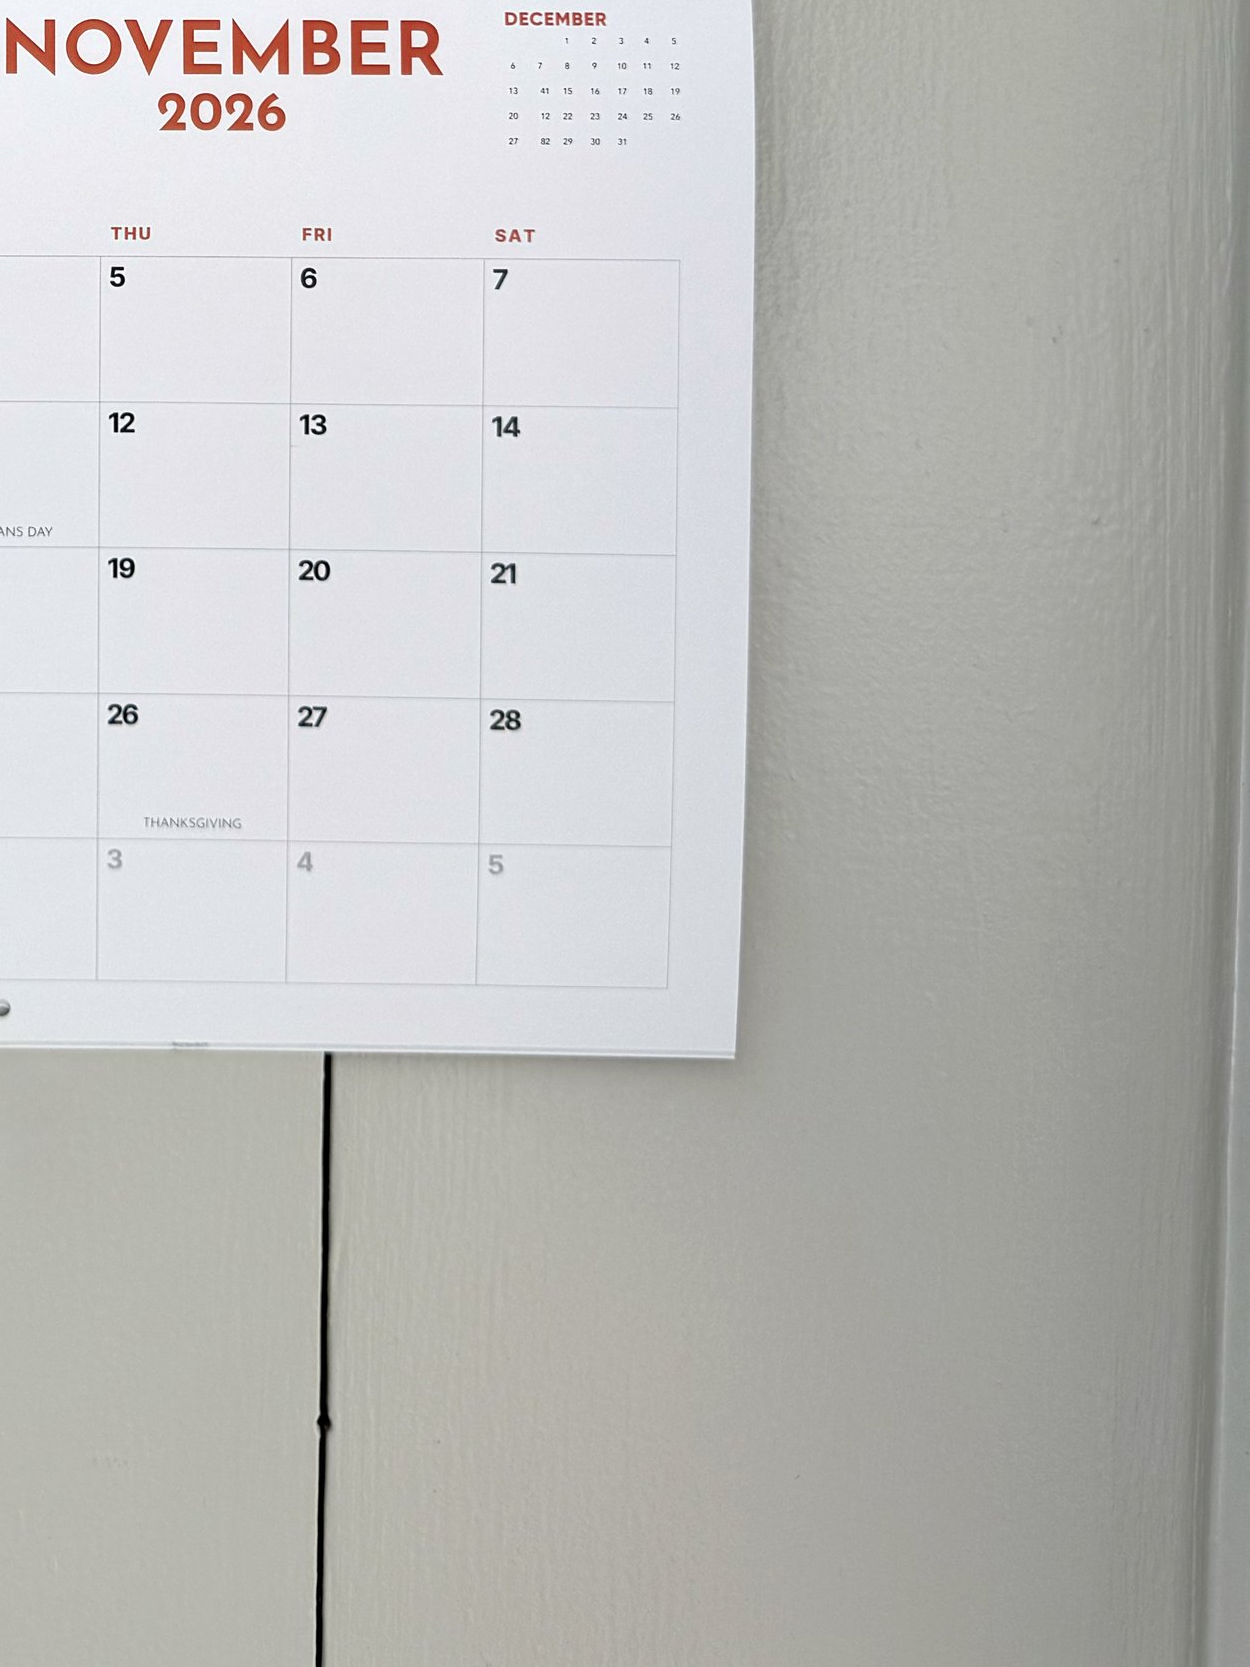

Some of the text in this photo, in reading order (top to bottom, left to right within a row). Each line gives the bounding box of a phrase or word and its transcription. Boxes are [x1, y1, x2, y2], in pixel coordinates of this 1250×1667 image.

[504, 11, 607, 27] DECEMBER
[5, 16, 444, 77] NOVEMBER
[591, 36, 597, 45] 2
[618, 37, 625, 45] 3
[643, 37, 650, 45] 4
[671, 37, 677, 46] 5
[510, 61, 680, 71] 6 7 8 9 10 11 12
[508, 86, 519, 95] 13
[563, 87, 573, 95] 15
[590, 87, 601, 96] 16
[617, 87, 628, 95] 17
[643, 87, 654, 96] 18
[670, 87, 681, 96] 19
[157, 92, 287, 132] 2026
[508, 111, 519, 120] 20
[562, 112, 573, 121] 22
[589, 112, 601, 121] 23
[617, 112, 628, 121] 24
[642, 112, 654, 121] 25
[670, 112, 681, 121] 26
[508, 137, 519, 146] 27
[562, 137, 574, 146] 29
[590, 137, 601, 146] 30
[617, 137, 627, 146] 31
[110, 226, 151, 241] THU
[301, 227, 332, 242] FRI
[494, 228, 536, 243] SAT
[109, 265, 126, 288] 5
[300, 266, 318, 290] 6
[492, 268, 509, 291] 7
[108, 411, 136, 434] 12
[298, 413, 328, 436] 13
[491, 415, 522, 438] 14
[27, 525, 53, 538] DAY
[107, 556, 136, 580] 19
[297, 559, 332, 583] 20
[490, 561, 517, 585] 21
[107, 703, 140, 727] 26
[297, 705, 328, 729] 27
[489, 708, 522, 732] 28
[144, 816, 242, 830] THANKSGIVING
[107, 848, 123, 870] 3
[296, 851, 314, 873] 4
[488, 854, 505, 876] 5
